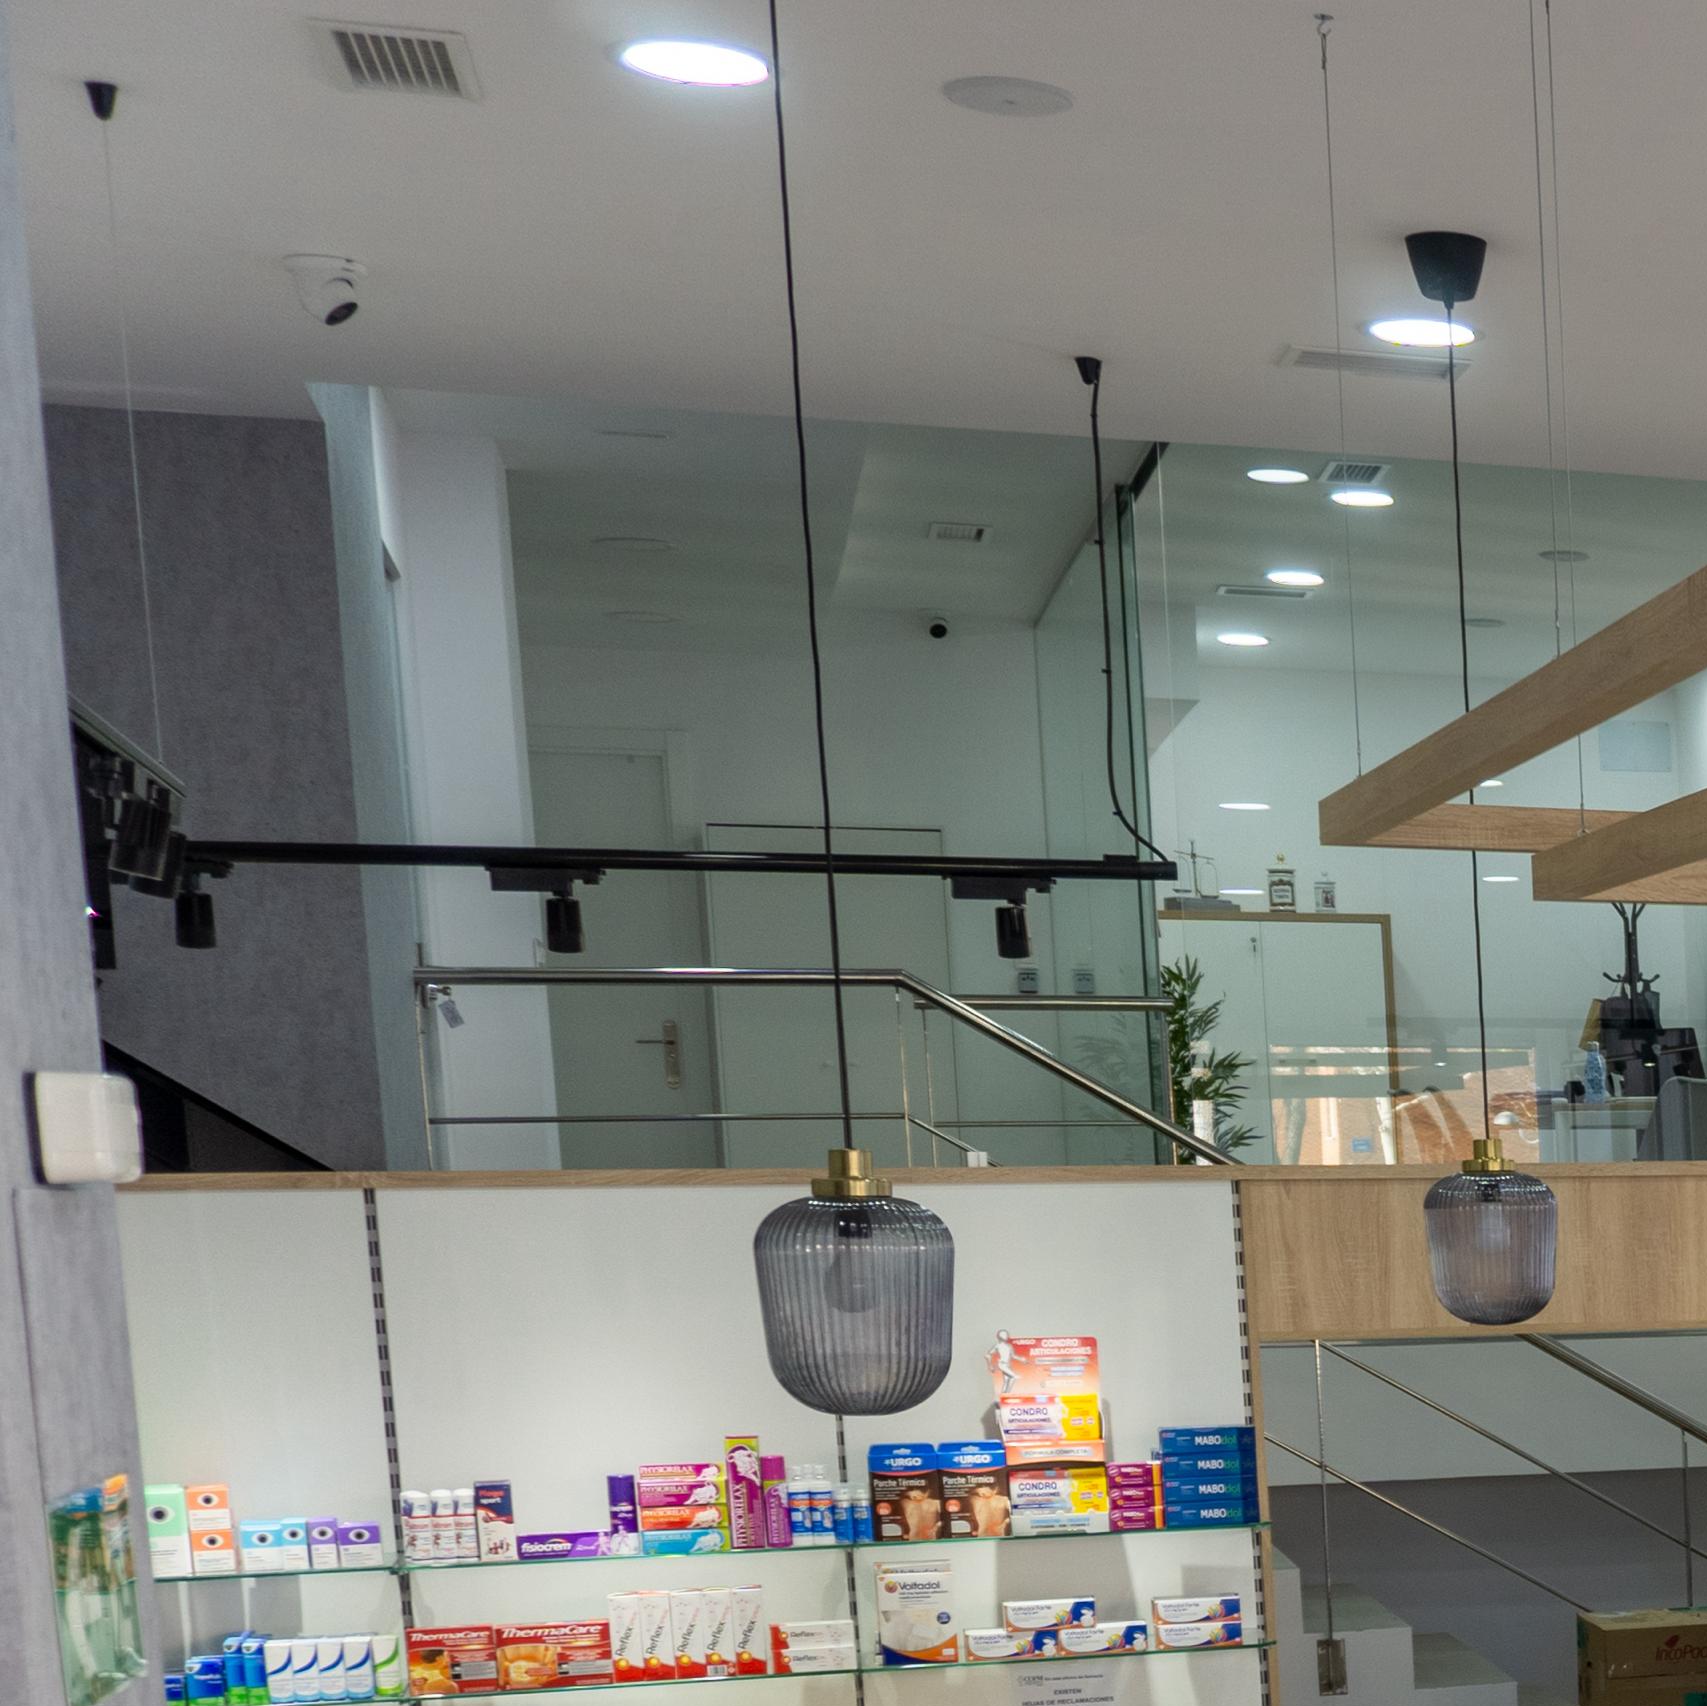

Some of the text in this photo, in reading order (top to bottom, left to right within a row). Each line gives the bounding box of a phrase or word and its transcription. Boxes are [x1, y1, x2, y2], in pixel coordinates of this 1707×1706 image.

[1010, 1408, 1048, 1416] CONDRO
[890, 1458, 921, 1466] URGO
[959, 1455, 991, 1464] URGO
[1019, 1482, 1057, 1491] CONDRO
[521, 1541, 571, 1552] fisiocrem
[899, 1581, 940, 1590] Voltadol
[410, 1629, 488, 1641] ThermaCare
[502, 1625, 600, 1638] ThermaCare
[679, 1621, 696, 1653] Reflex
[708, 1620, 726, 1651] Reflex
[738, 1619, 756, 1651] Reflex
[616, 1625, 635, 1657] Reflex
[648, 1622, 665, 1656] Reflex
